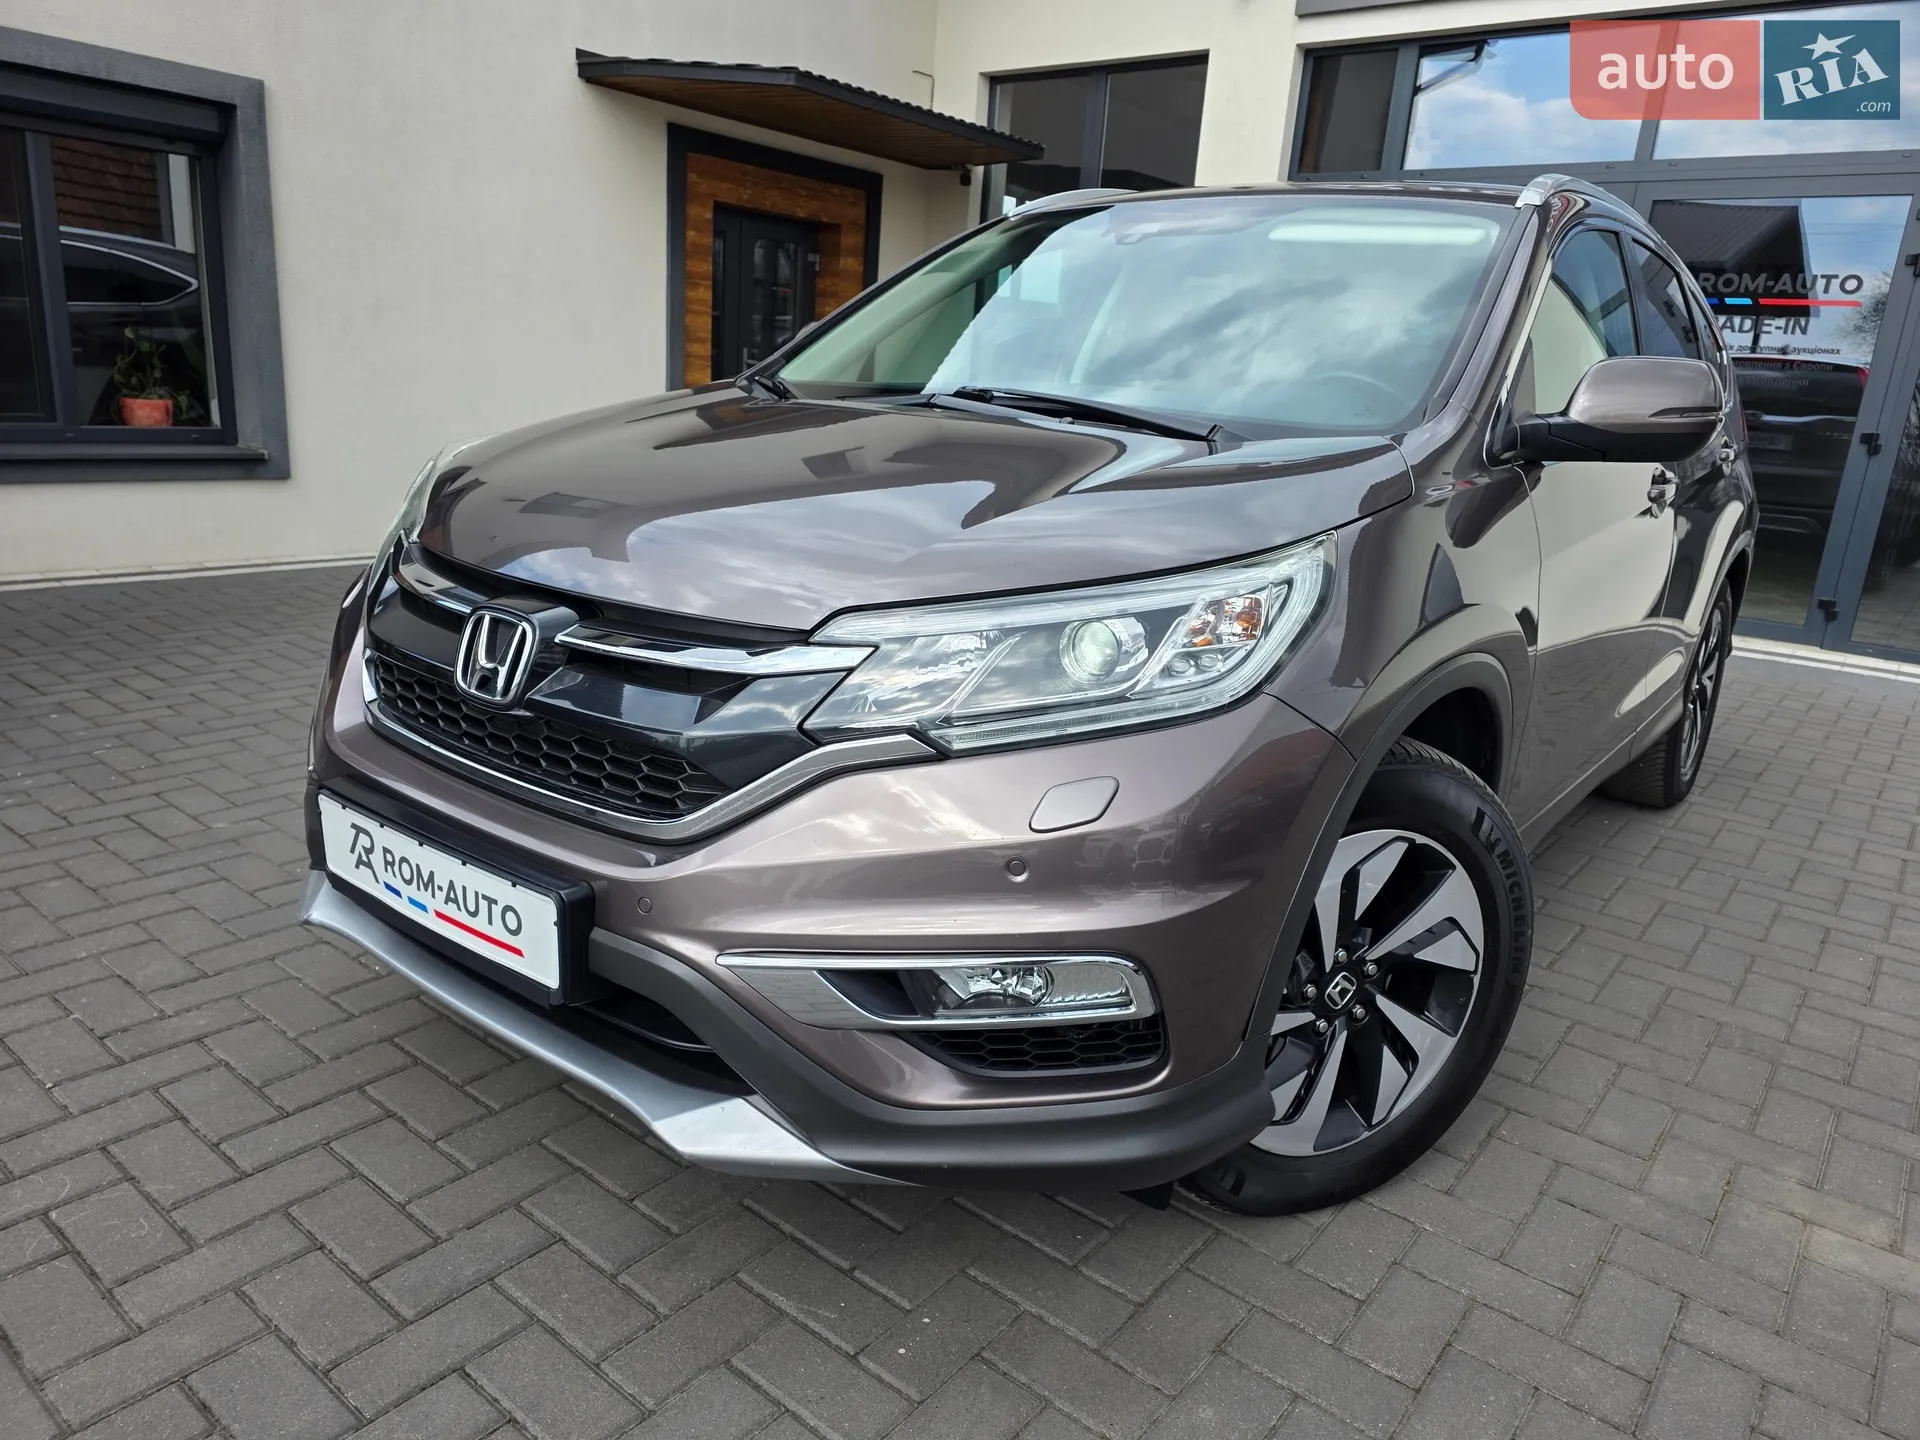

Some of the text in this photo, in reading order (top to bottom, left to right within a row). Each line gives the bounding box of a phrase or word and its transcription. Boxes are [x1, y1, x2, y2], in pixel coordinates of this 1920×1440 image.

[1698, 272, 1864, 296] ROM-AUTO
[1717, 315, 1809, 336] ADE-IN
[382, 845, 523, 937] ROM-AUTO
[1496, 848, 1526, 974] MICHELIN
